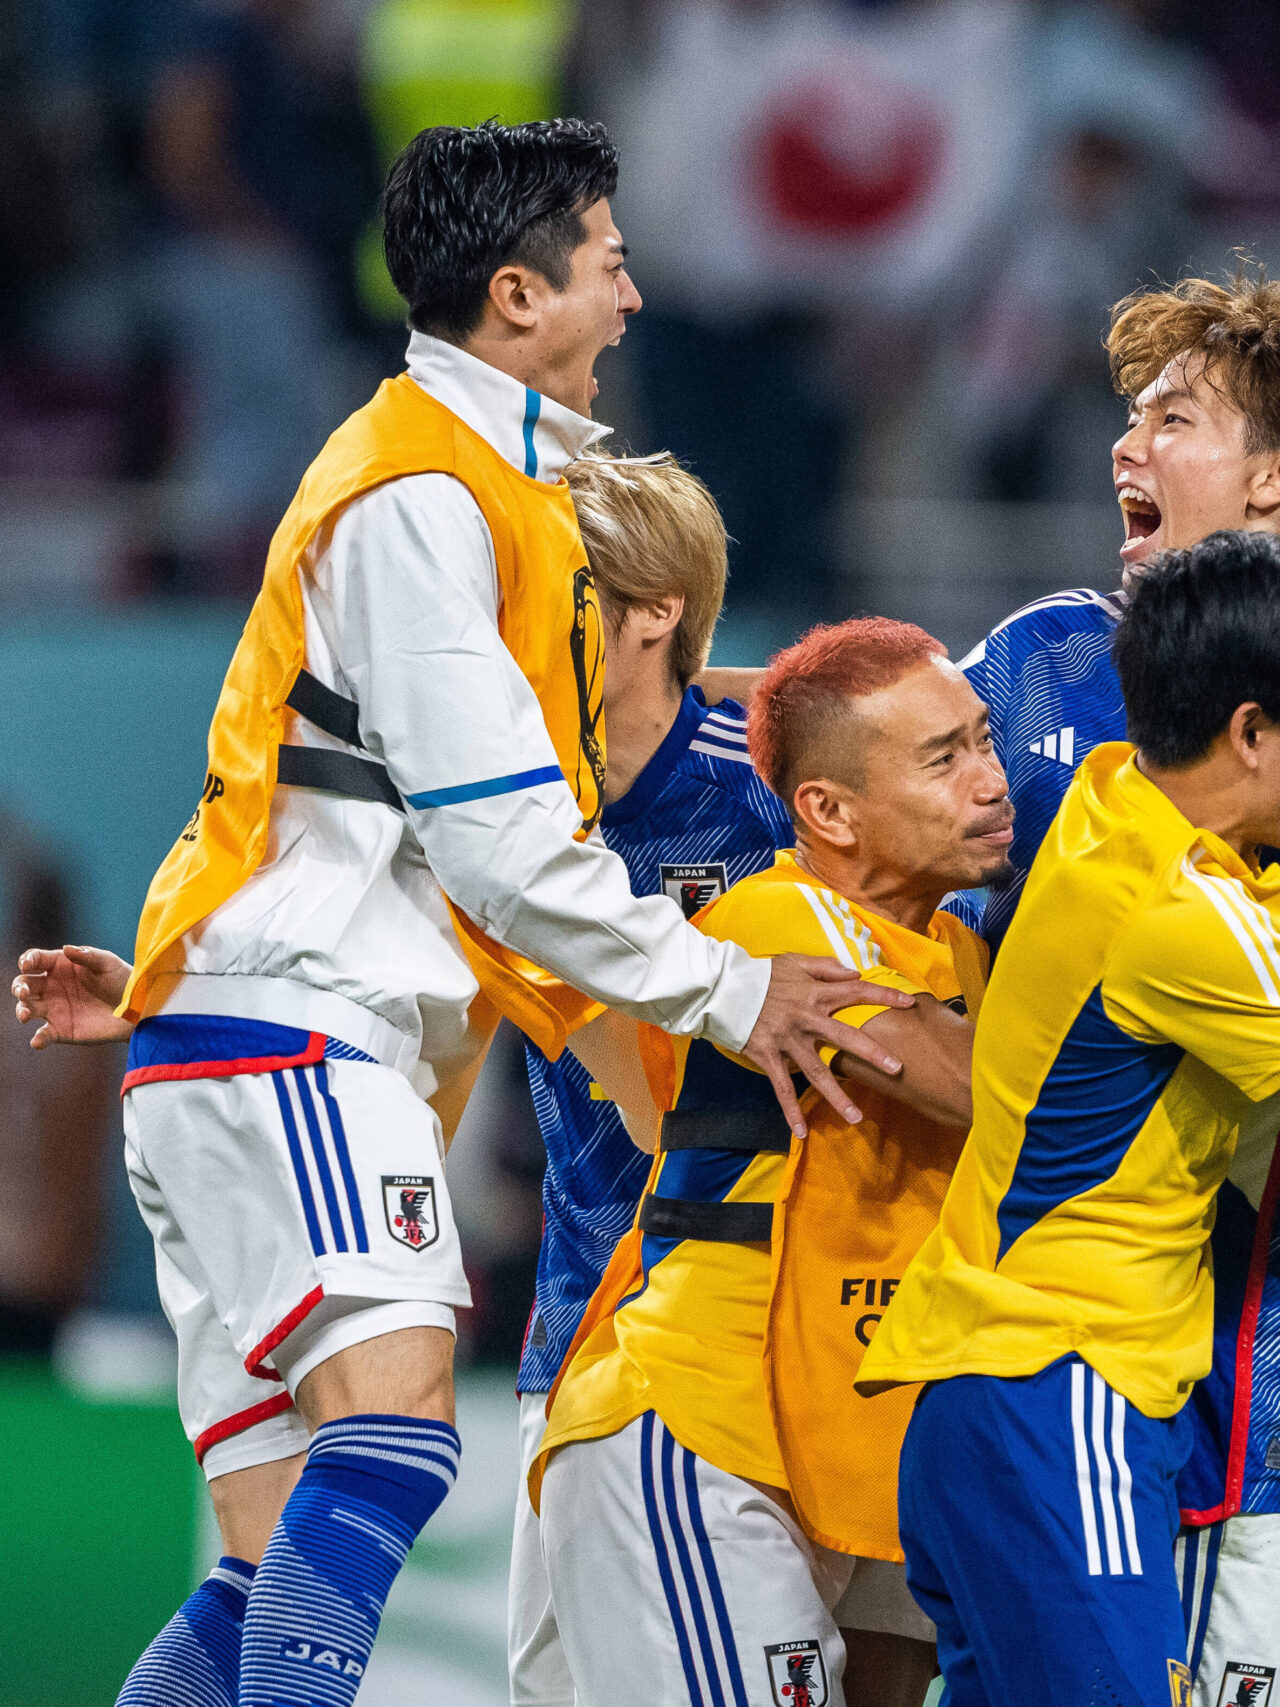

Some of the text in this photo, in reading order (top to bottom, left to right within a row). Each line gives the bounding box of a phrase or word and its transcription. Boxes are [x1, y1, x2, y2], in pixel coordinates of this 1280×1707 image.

[672, 868, 706, 877] JAPAN
[778, 1642, 809, 1652] JAPAN
[284, 1643, 364, 1677] JAP
[1237, 1664, 1266, 1675] JAPAN
